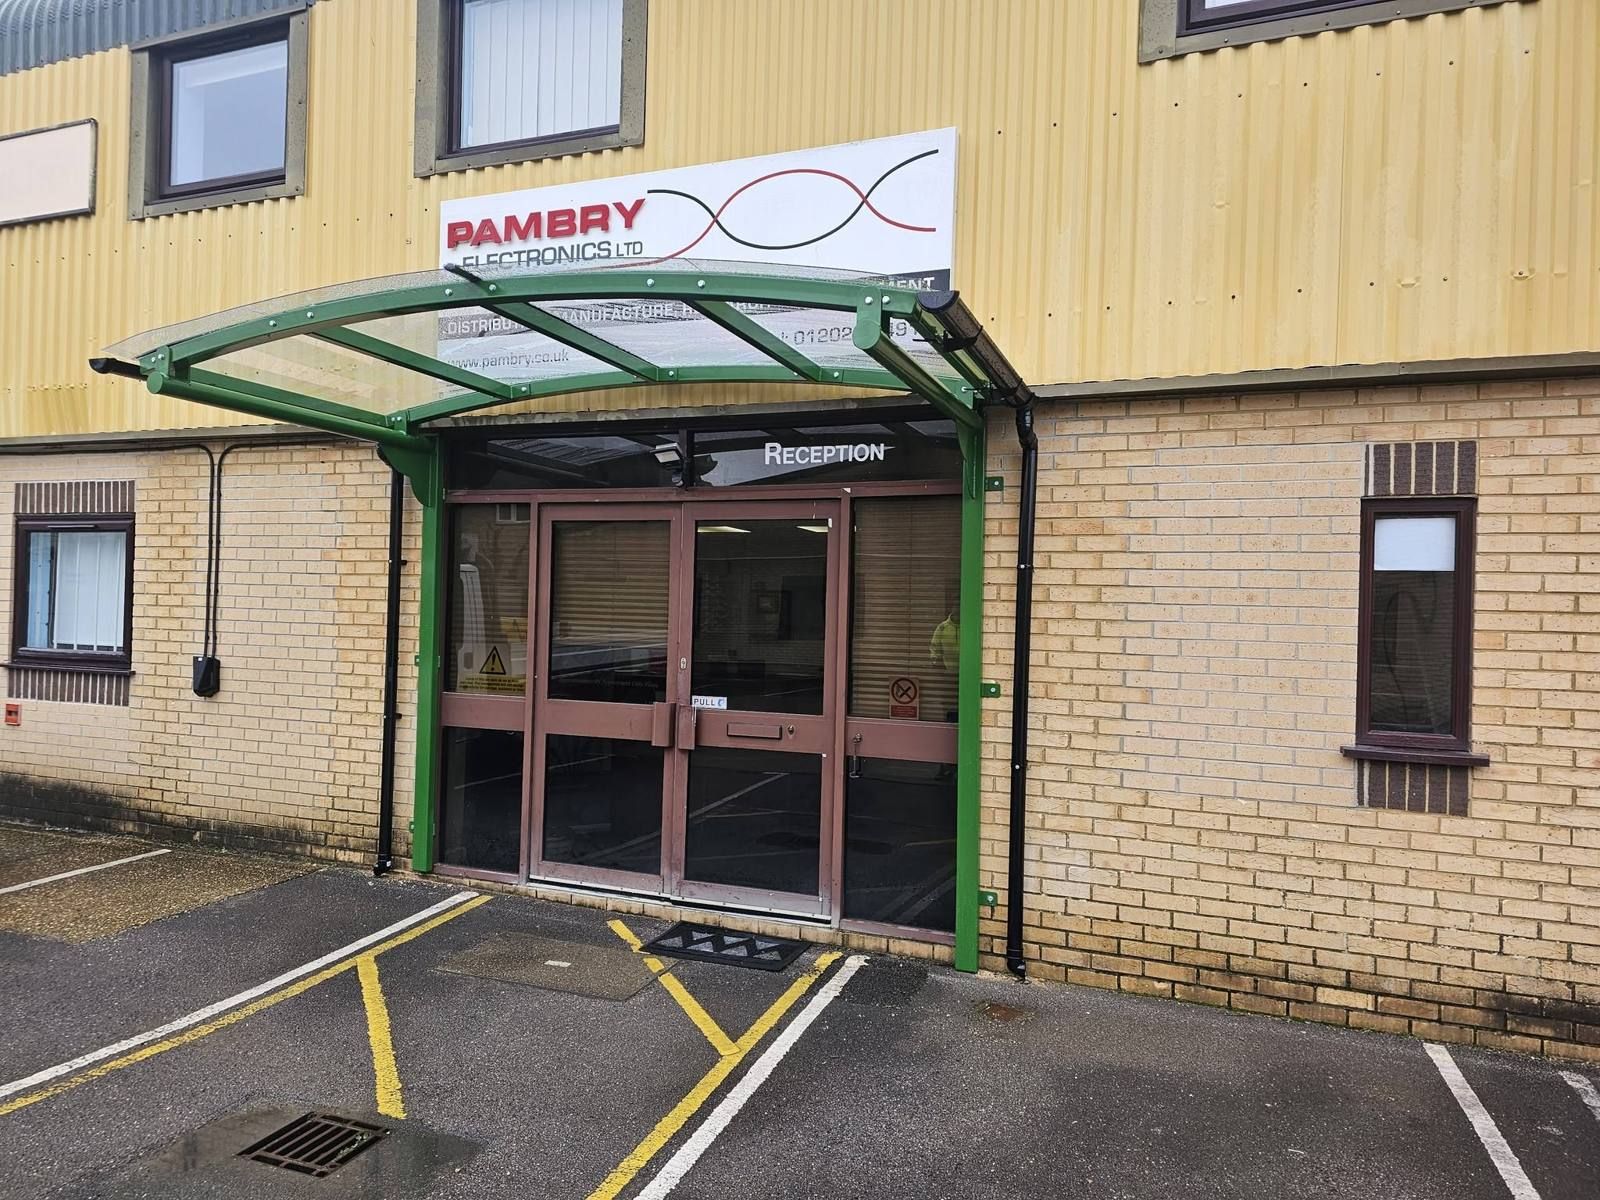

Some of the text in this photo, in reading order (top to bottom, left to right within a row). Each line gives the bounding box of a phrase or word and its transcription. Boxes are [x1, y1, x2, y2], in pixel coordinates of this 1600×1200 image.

[447, 198, 646, 248] PAMBRY
[462, 240, 644, 268] ELECTRONICS LTD
[764, 442, 885, 465] RECEPTION
[693, 698, 715, 706] PULL
